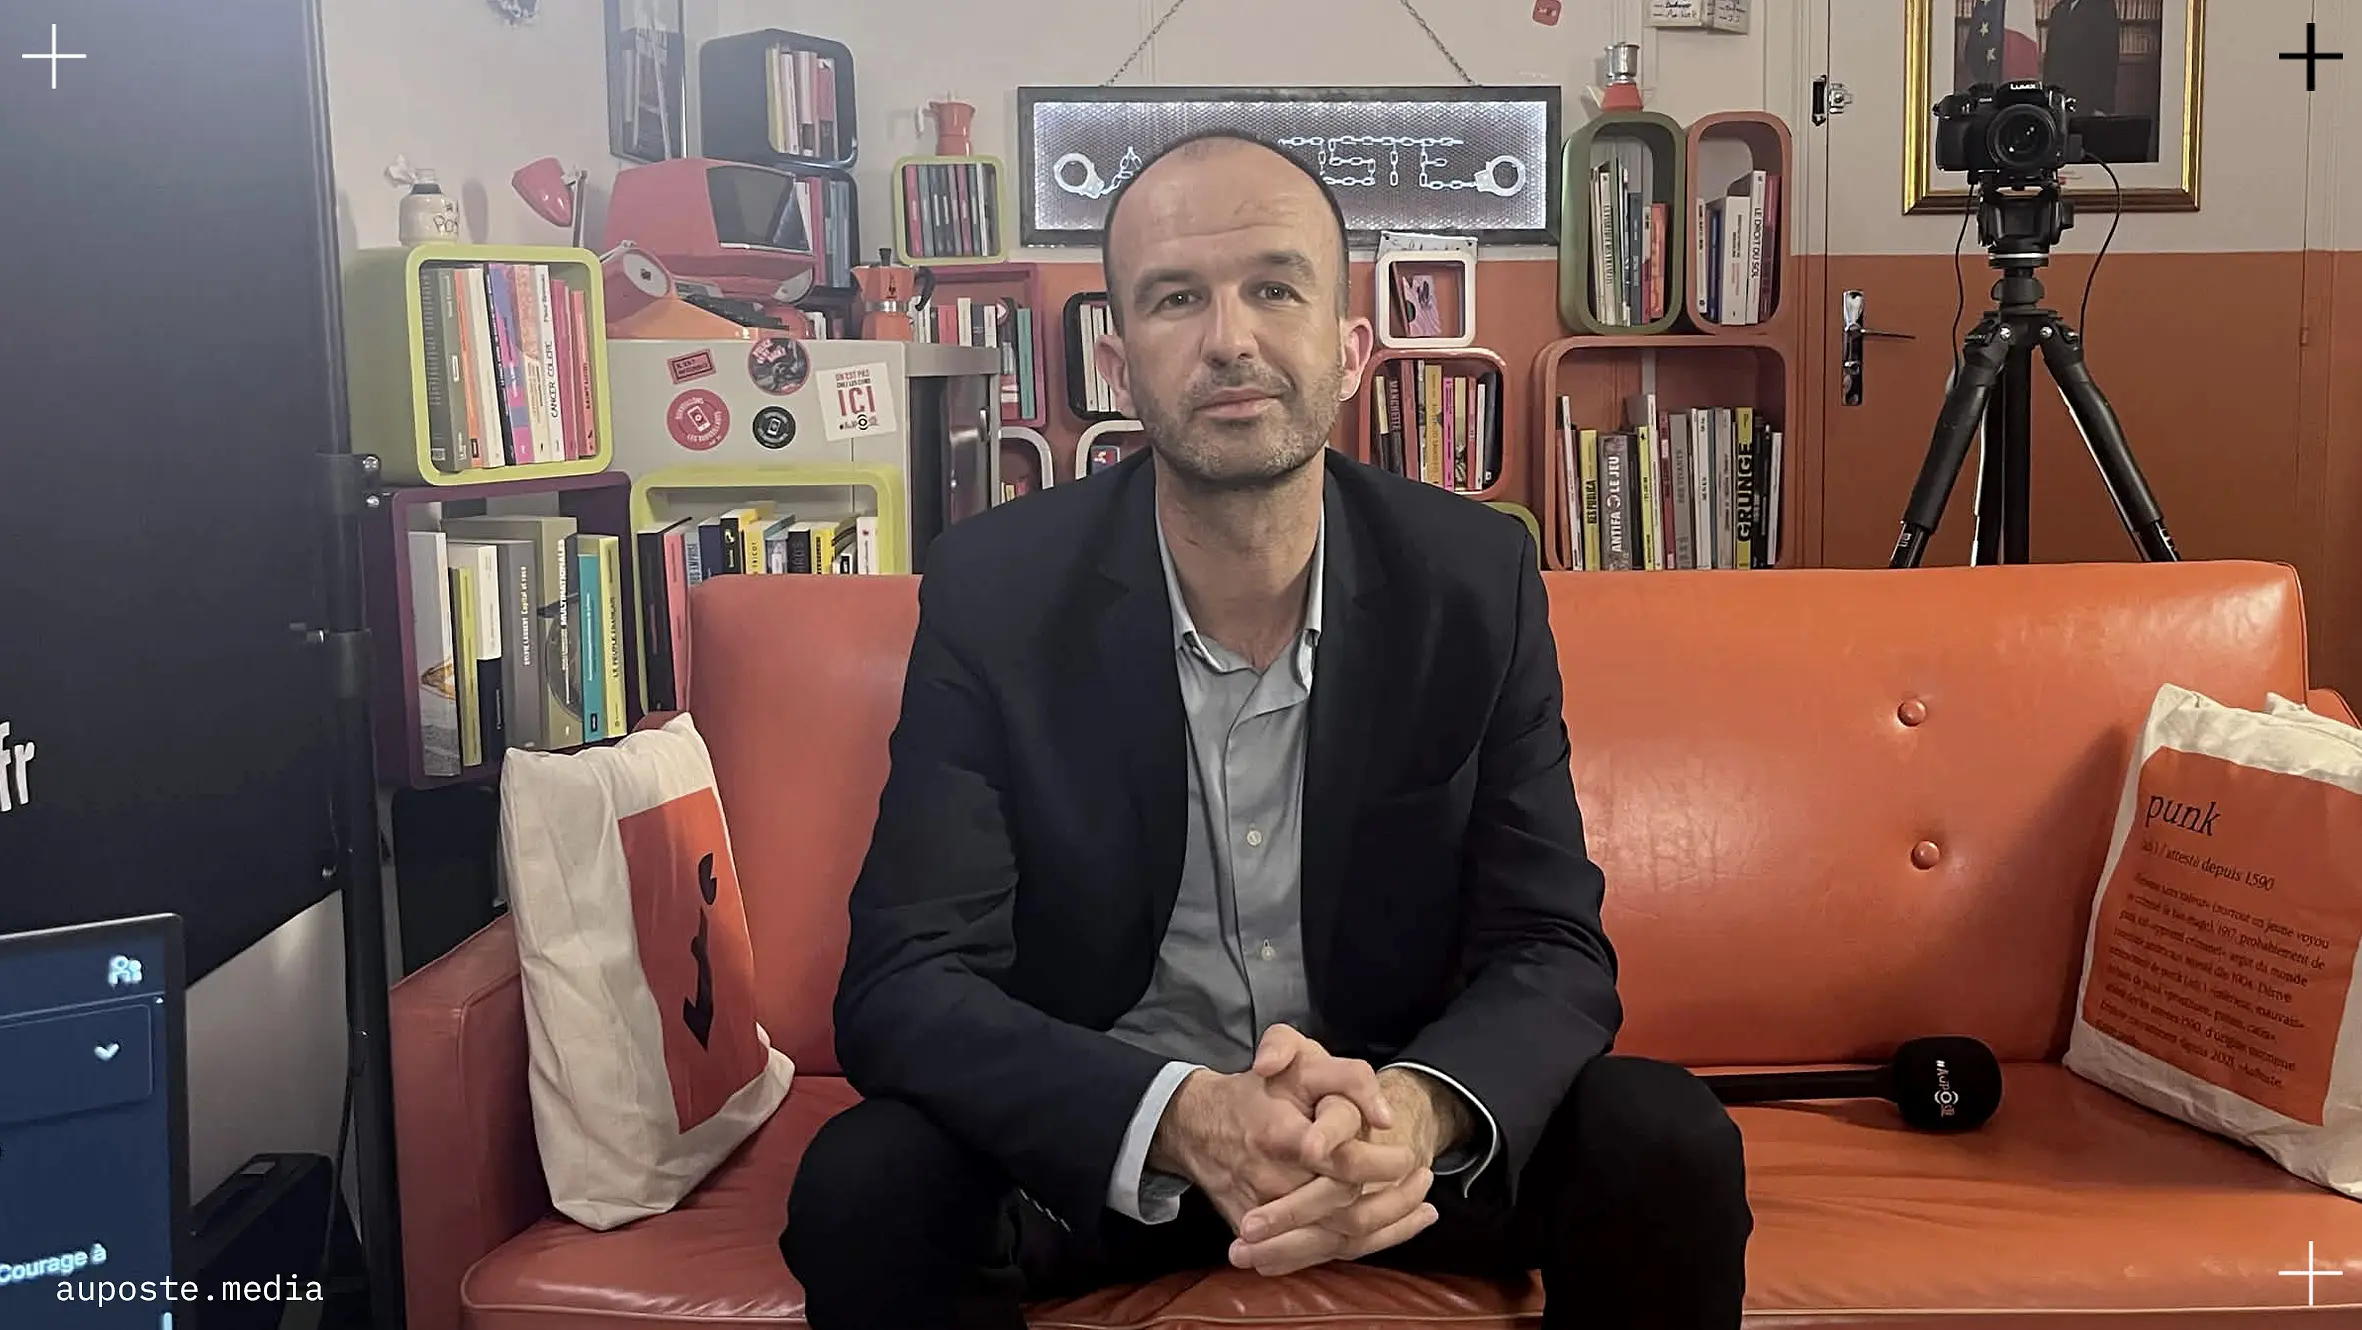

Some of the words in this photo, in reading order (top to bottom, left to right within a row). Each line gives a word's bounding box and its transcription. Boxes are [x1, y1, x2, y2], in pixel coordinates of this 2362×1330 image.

[1754, 207, 1762, 217] LE
[1753, 219, 1761, 245] DROIT
[1752, 247, 1760, 260] DU
[838, 386, 876, 416] ICI
[1608, 456, 1620, 478] JEU
[1609, 479, 1619, 493] LE
[1738, 441, 1753, 542] GRUNGE
[1610, 511, 1622, 552] ANTIFA
[558, 539, 567, 626] MULTINATIONALES
[520, 592, 528, 615] Capital
[2146, 795, 2221, 836] punk
[2201, 856, 2241, 882] depuis
[2244, 869, 2275, 892] 1590
[2296, 928, 2330, 950] voyou
[2310, 955, 2326, 971] de
[2269, 964, 2309, 987] monde
[0, 1250, 88, 1286] Courage
[89, 1243, 107, 1265] à
